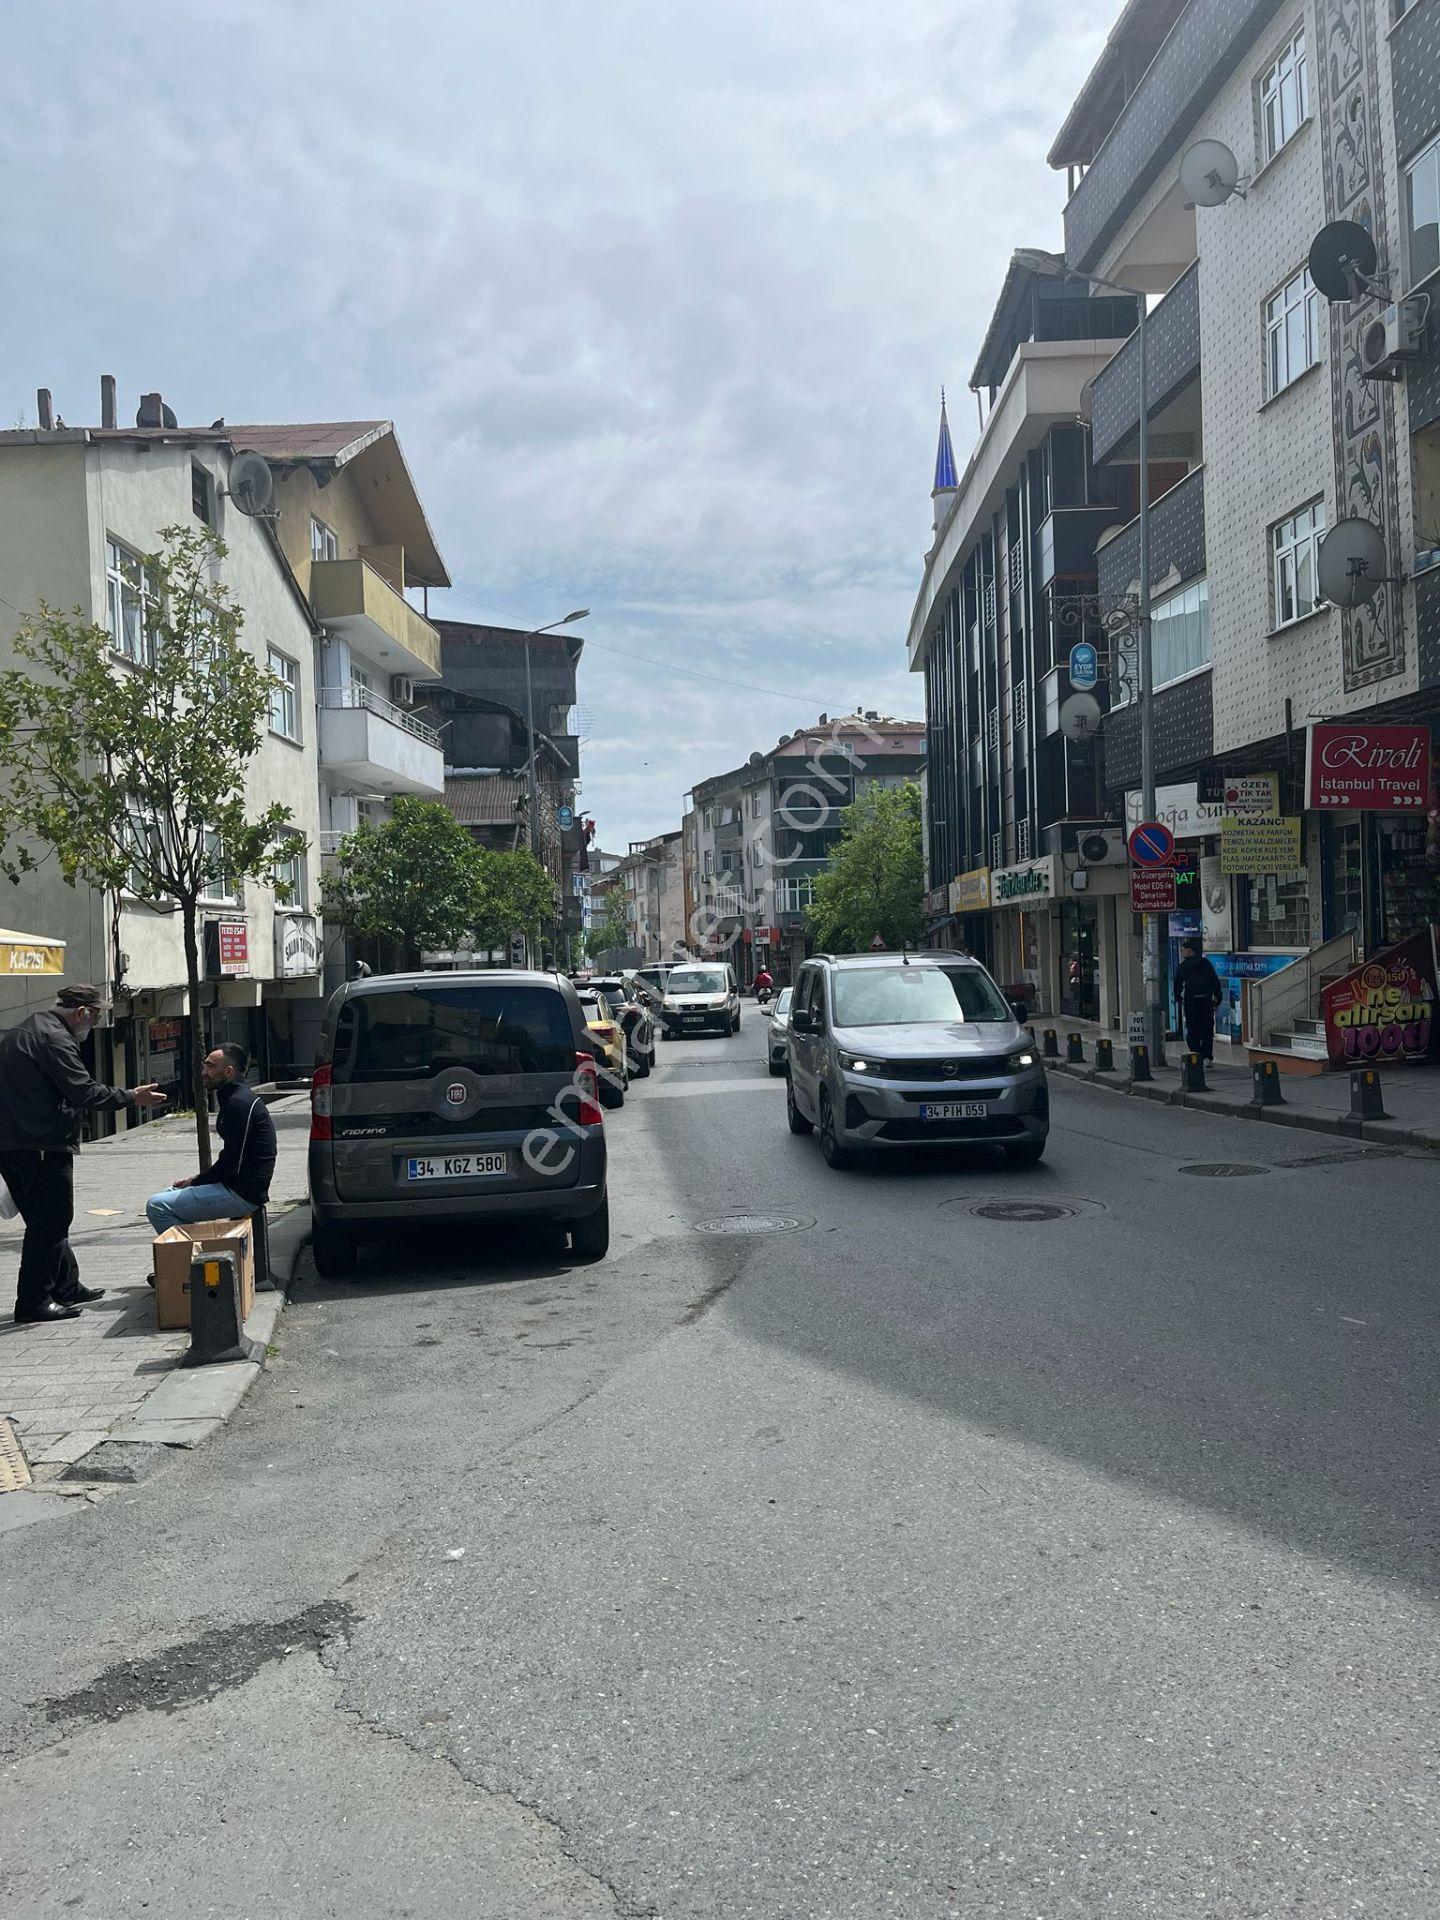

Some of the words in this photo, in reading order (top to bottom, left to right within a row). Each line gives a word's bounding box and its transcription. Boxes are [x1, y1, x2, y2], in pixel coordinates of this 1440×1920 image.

[1321, 735, 1424, 768] Rivoli
[1241, 779, 1269, 789] ÖZEN
[1320, 774, 1374, 789] İstanbul
[1378, 778, 1420, 790] Travel
[1256, 789, 1272, 797] TAK
[1238, 818, 1285, 826] KAZANCI
[1175, 872, 1196, 884] RAT
[1134, 882, 1150, 890] Mobil
[1151, 882, 1164, 890] EDS
[1140, 891, 1167, 899] Denetim
[1367, 986, 1402, 1006] ne
[926, 1106, 940, 1118] 34
[943, 1105, 962, 1117] PIH
[965, 1104, 985, 1116] 059
[417, 1161, 434, 1176] 34
[444, 1158, 471, 1174] KGZ
[476, 1156, 502, 1172] 580
